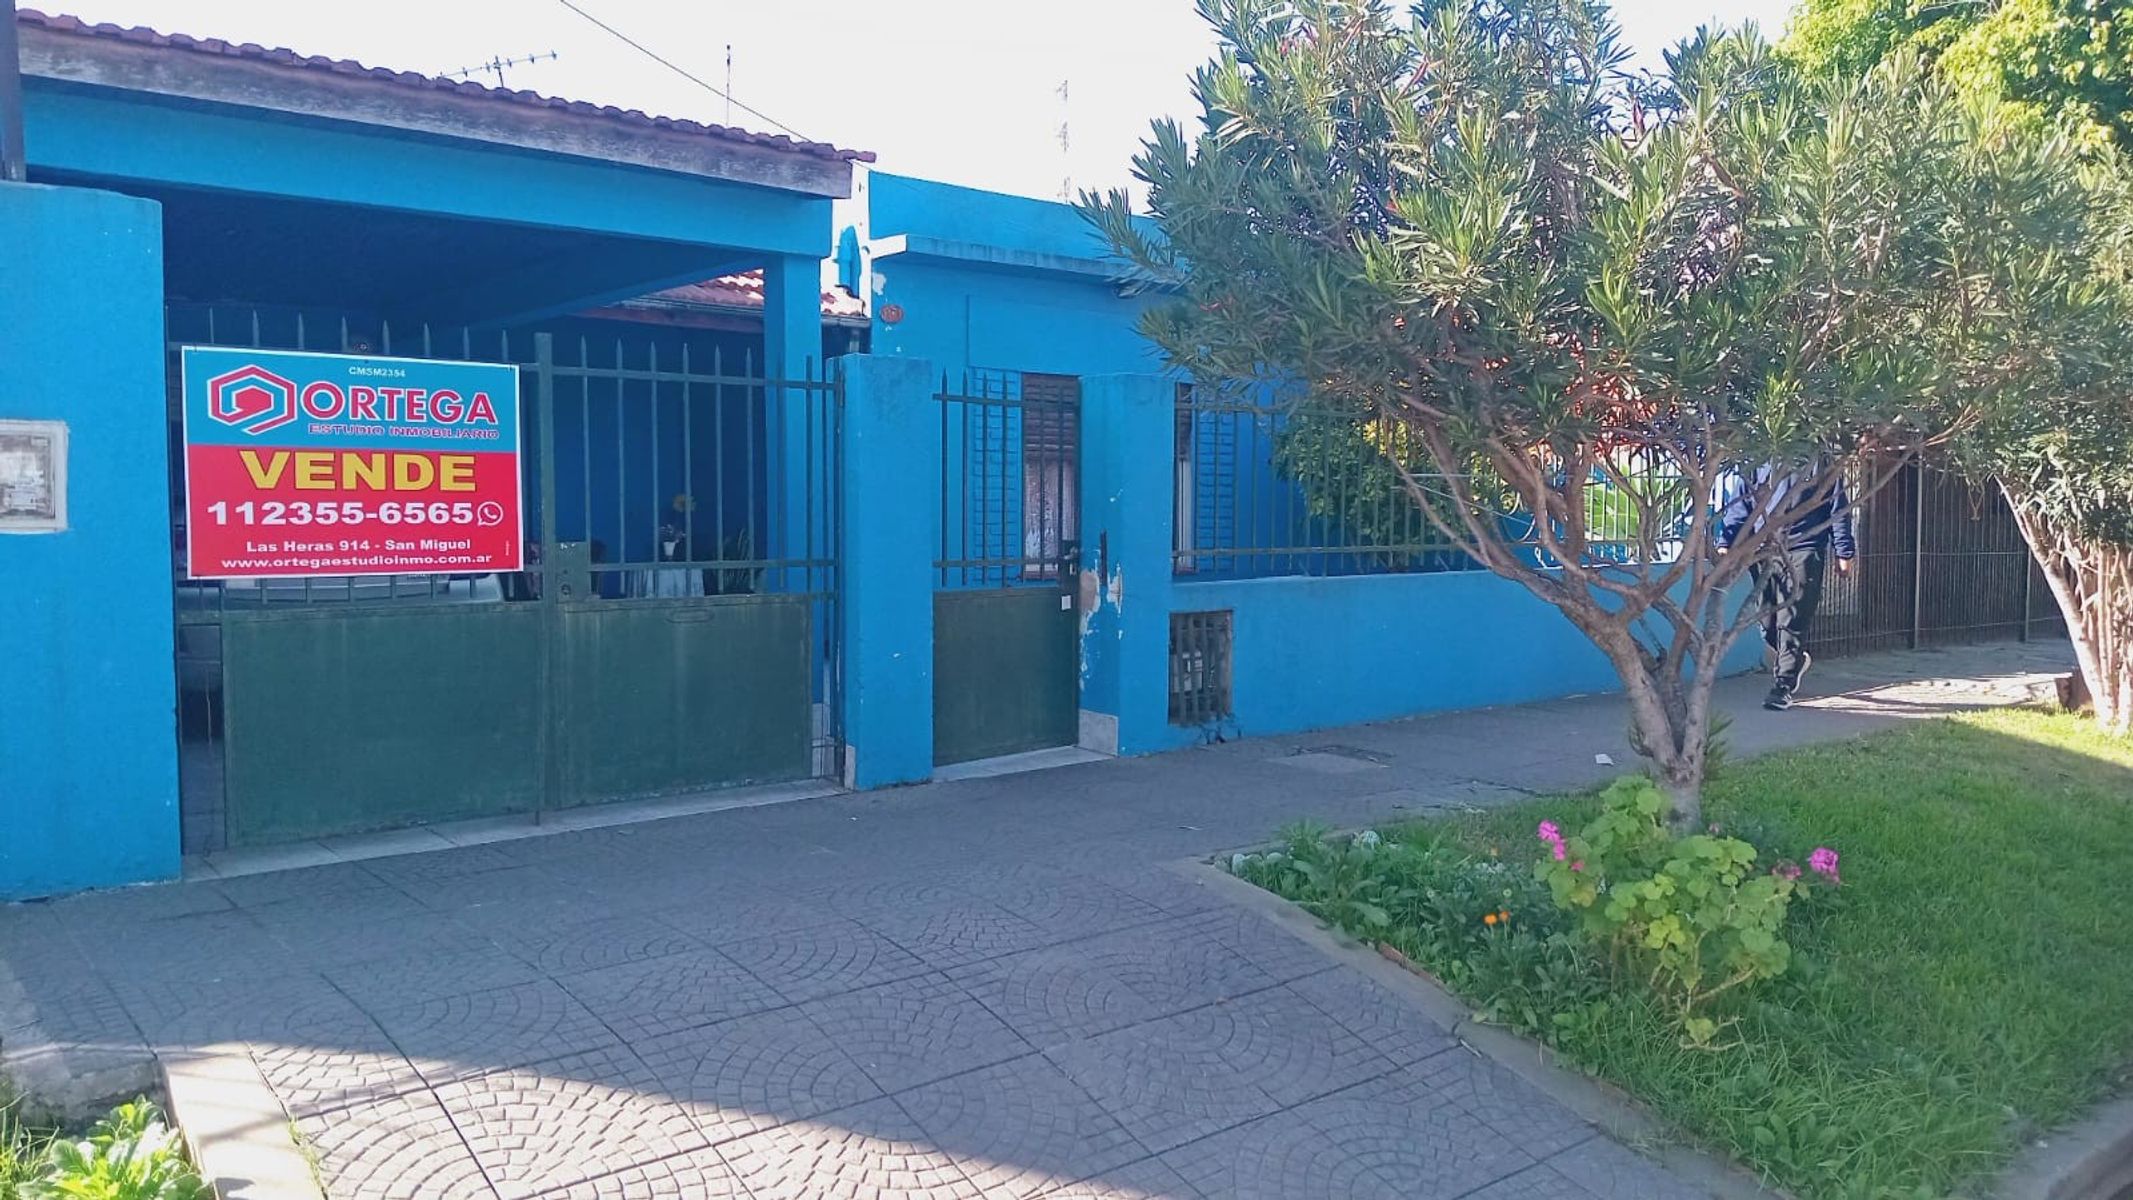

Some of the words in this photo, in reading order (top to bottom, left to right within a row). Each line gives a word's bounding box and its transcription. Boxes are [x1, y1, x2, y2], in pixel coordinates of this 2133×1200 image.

[300, 381, 499, 425] ORTEGA
[308, 423, 385, 436] ESTUDIO
[389, 426, 500, 440] INMOBILIARIO
[239, 450, 476, 491] VENDE
[207, 501, 473, 525] 112355-6565
[246, 541, 278, 552] Las
[283, 541, 334, 552] Heras
[339, 540, 370, 551] 914
[385, 540, 415, 550] San
[420, 539, 471, 551] Miguel
[221, 554, 492, 569] www.ortegaestudioinmo.com.ar
